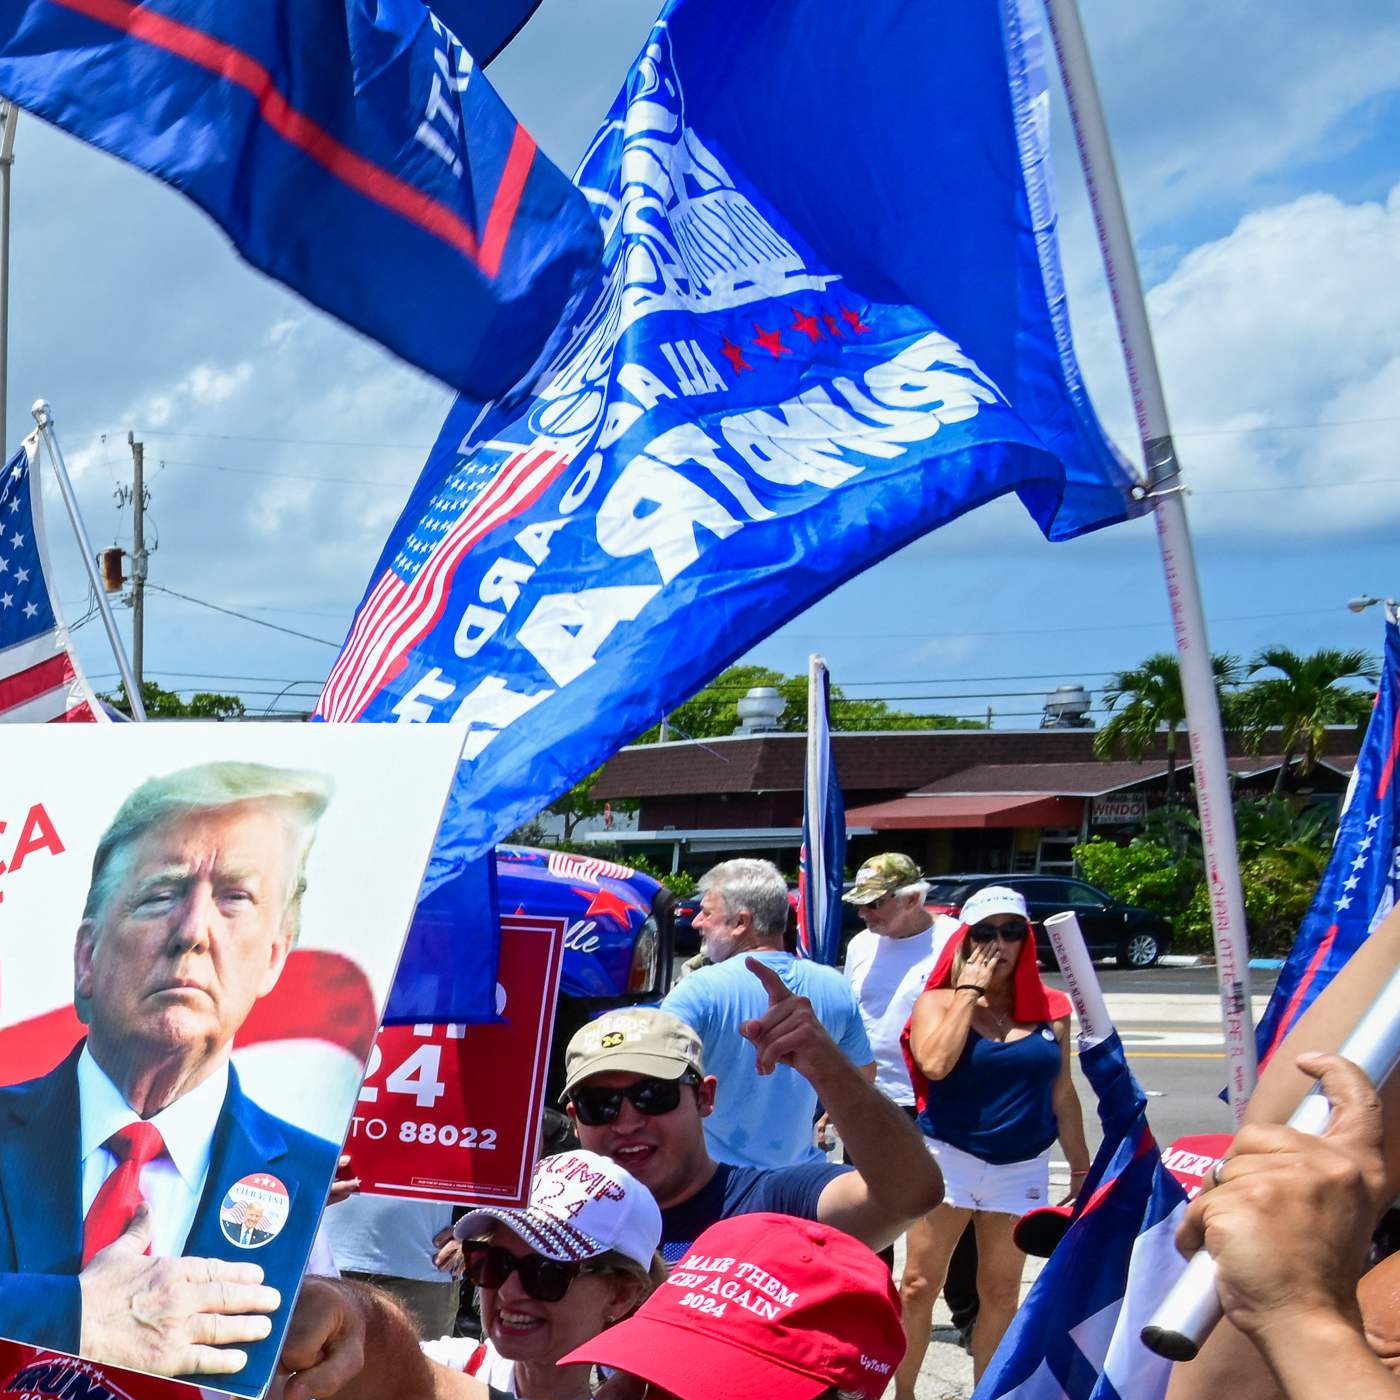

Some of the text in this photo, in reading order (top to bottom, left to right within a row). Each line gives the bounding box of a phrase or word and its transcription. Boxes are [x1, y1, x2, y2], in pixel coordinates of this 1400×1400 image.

[352, 1117, 498, 1151] TO 88022
[667, 1271, 782, 1321] CRY AGAIN
[679, 1254, 800, 1308] MAKE THEM
[678, 1292, 729, 1319] 2024
